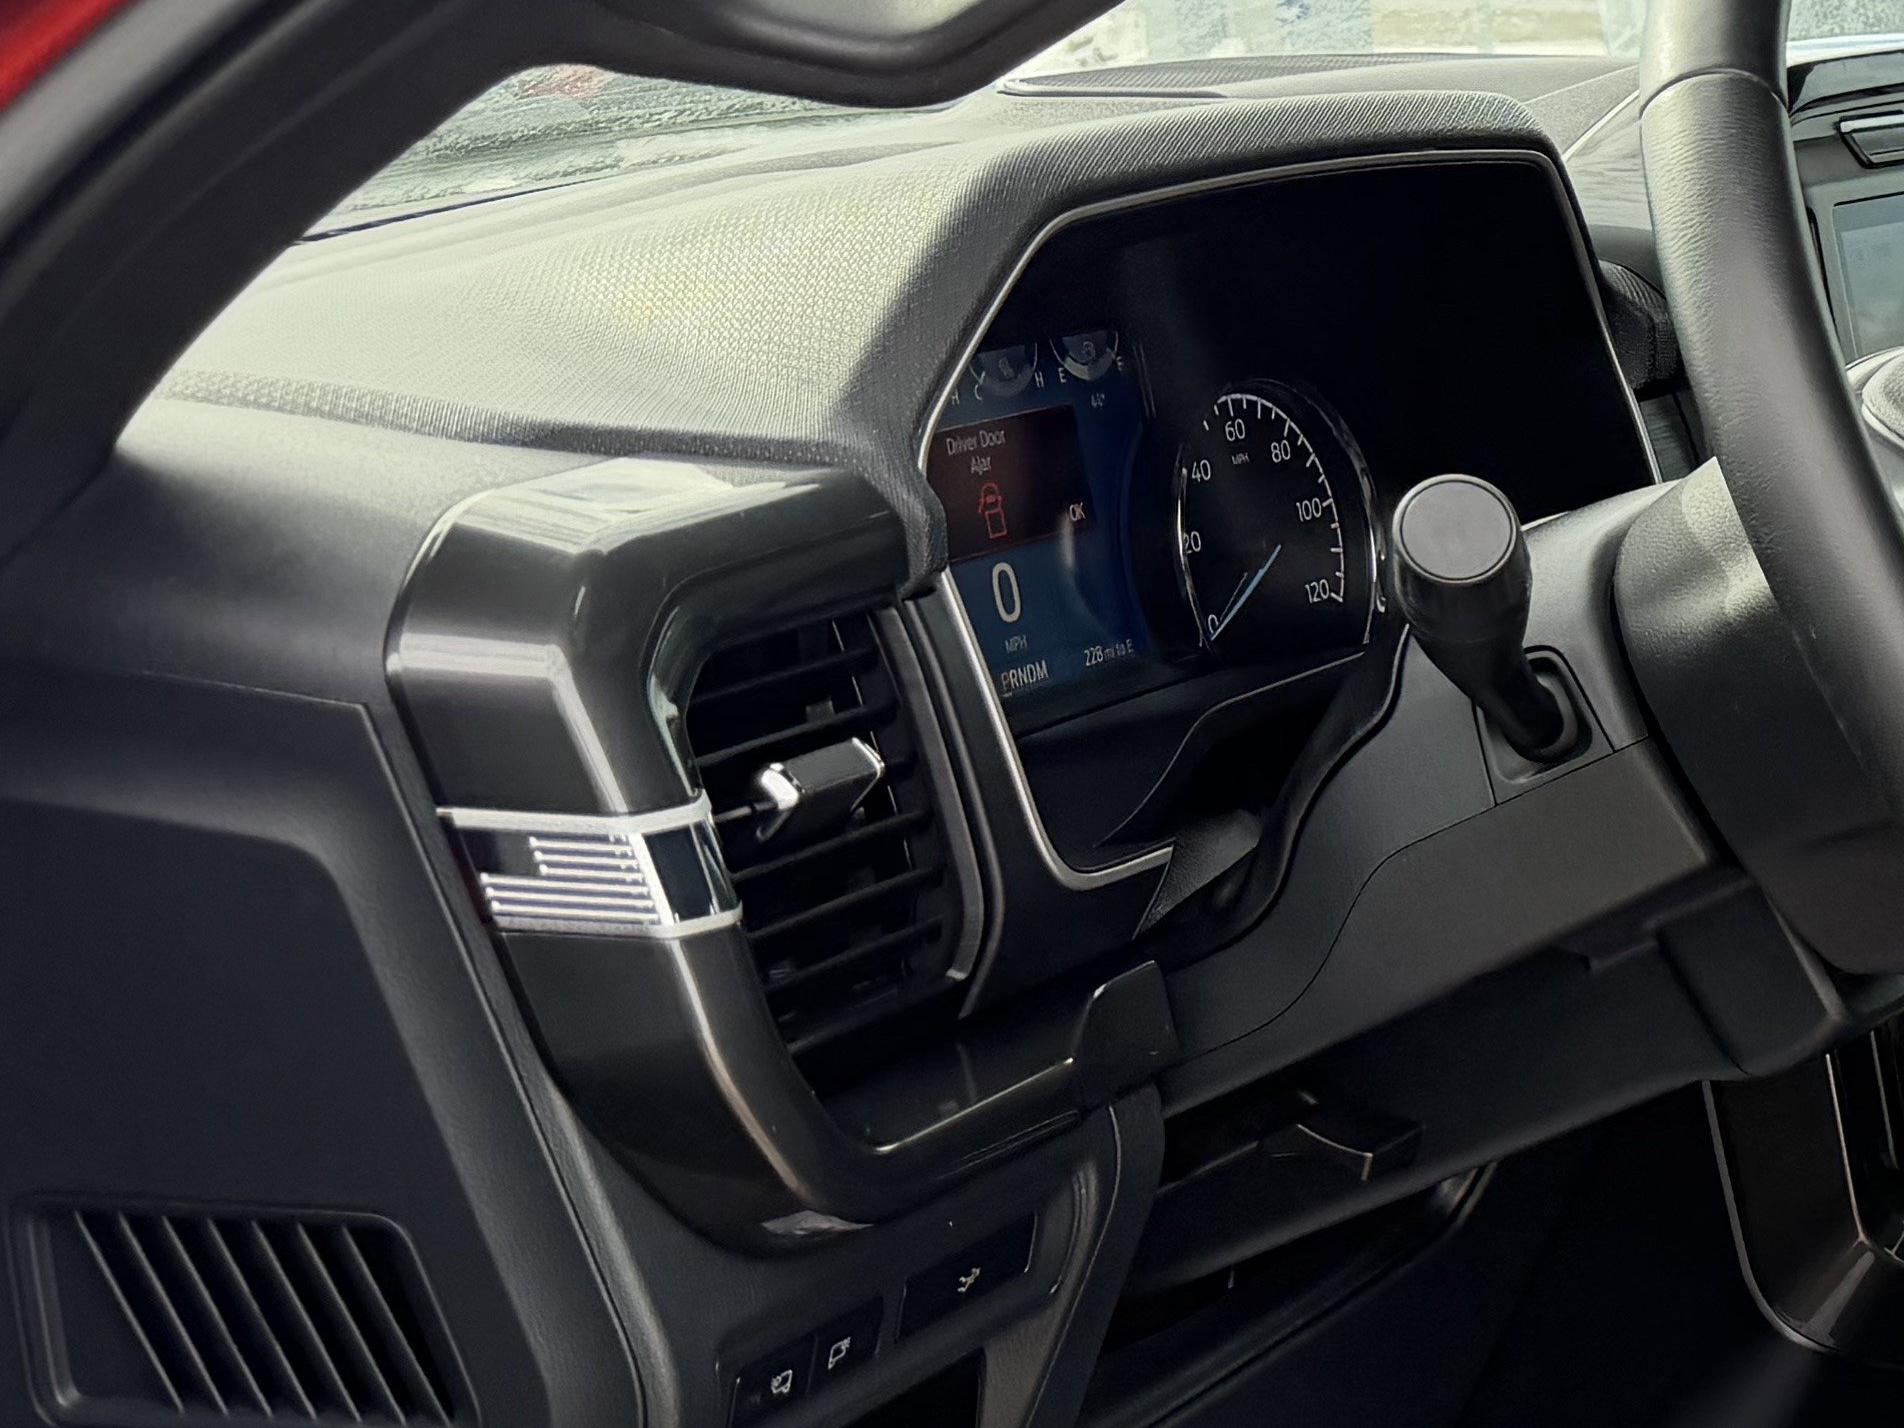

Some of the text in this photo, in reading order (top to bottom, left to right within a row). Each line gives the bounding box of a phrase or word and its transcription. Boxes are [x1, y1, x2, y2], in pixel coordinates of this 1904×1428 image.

[1225, 419, 1246, 442] 60
[945, 429, 1007, 456] Driver Door
[1271, 440, 1291, 463] 80
[1191, 459, 1212, 482] 40
[1068, 502, 1087, 522] OK
[1296, 497, 1323, 522] 100
[992, 562, 1022, 623] 0
[1305, 579, 1331, 603] 120
